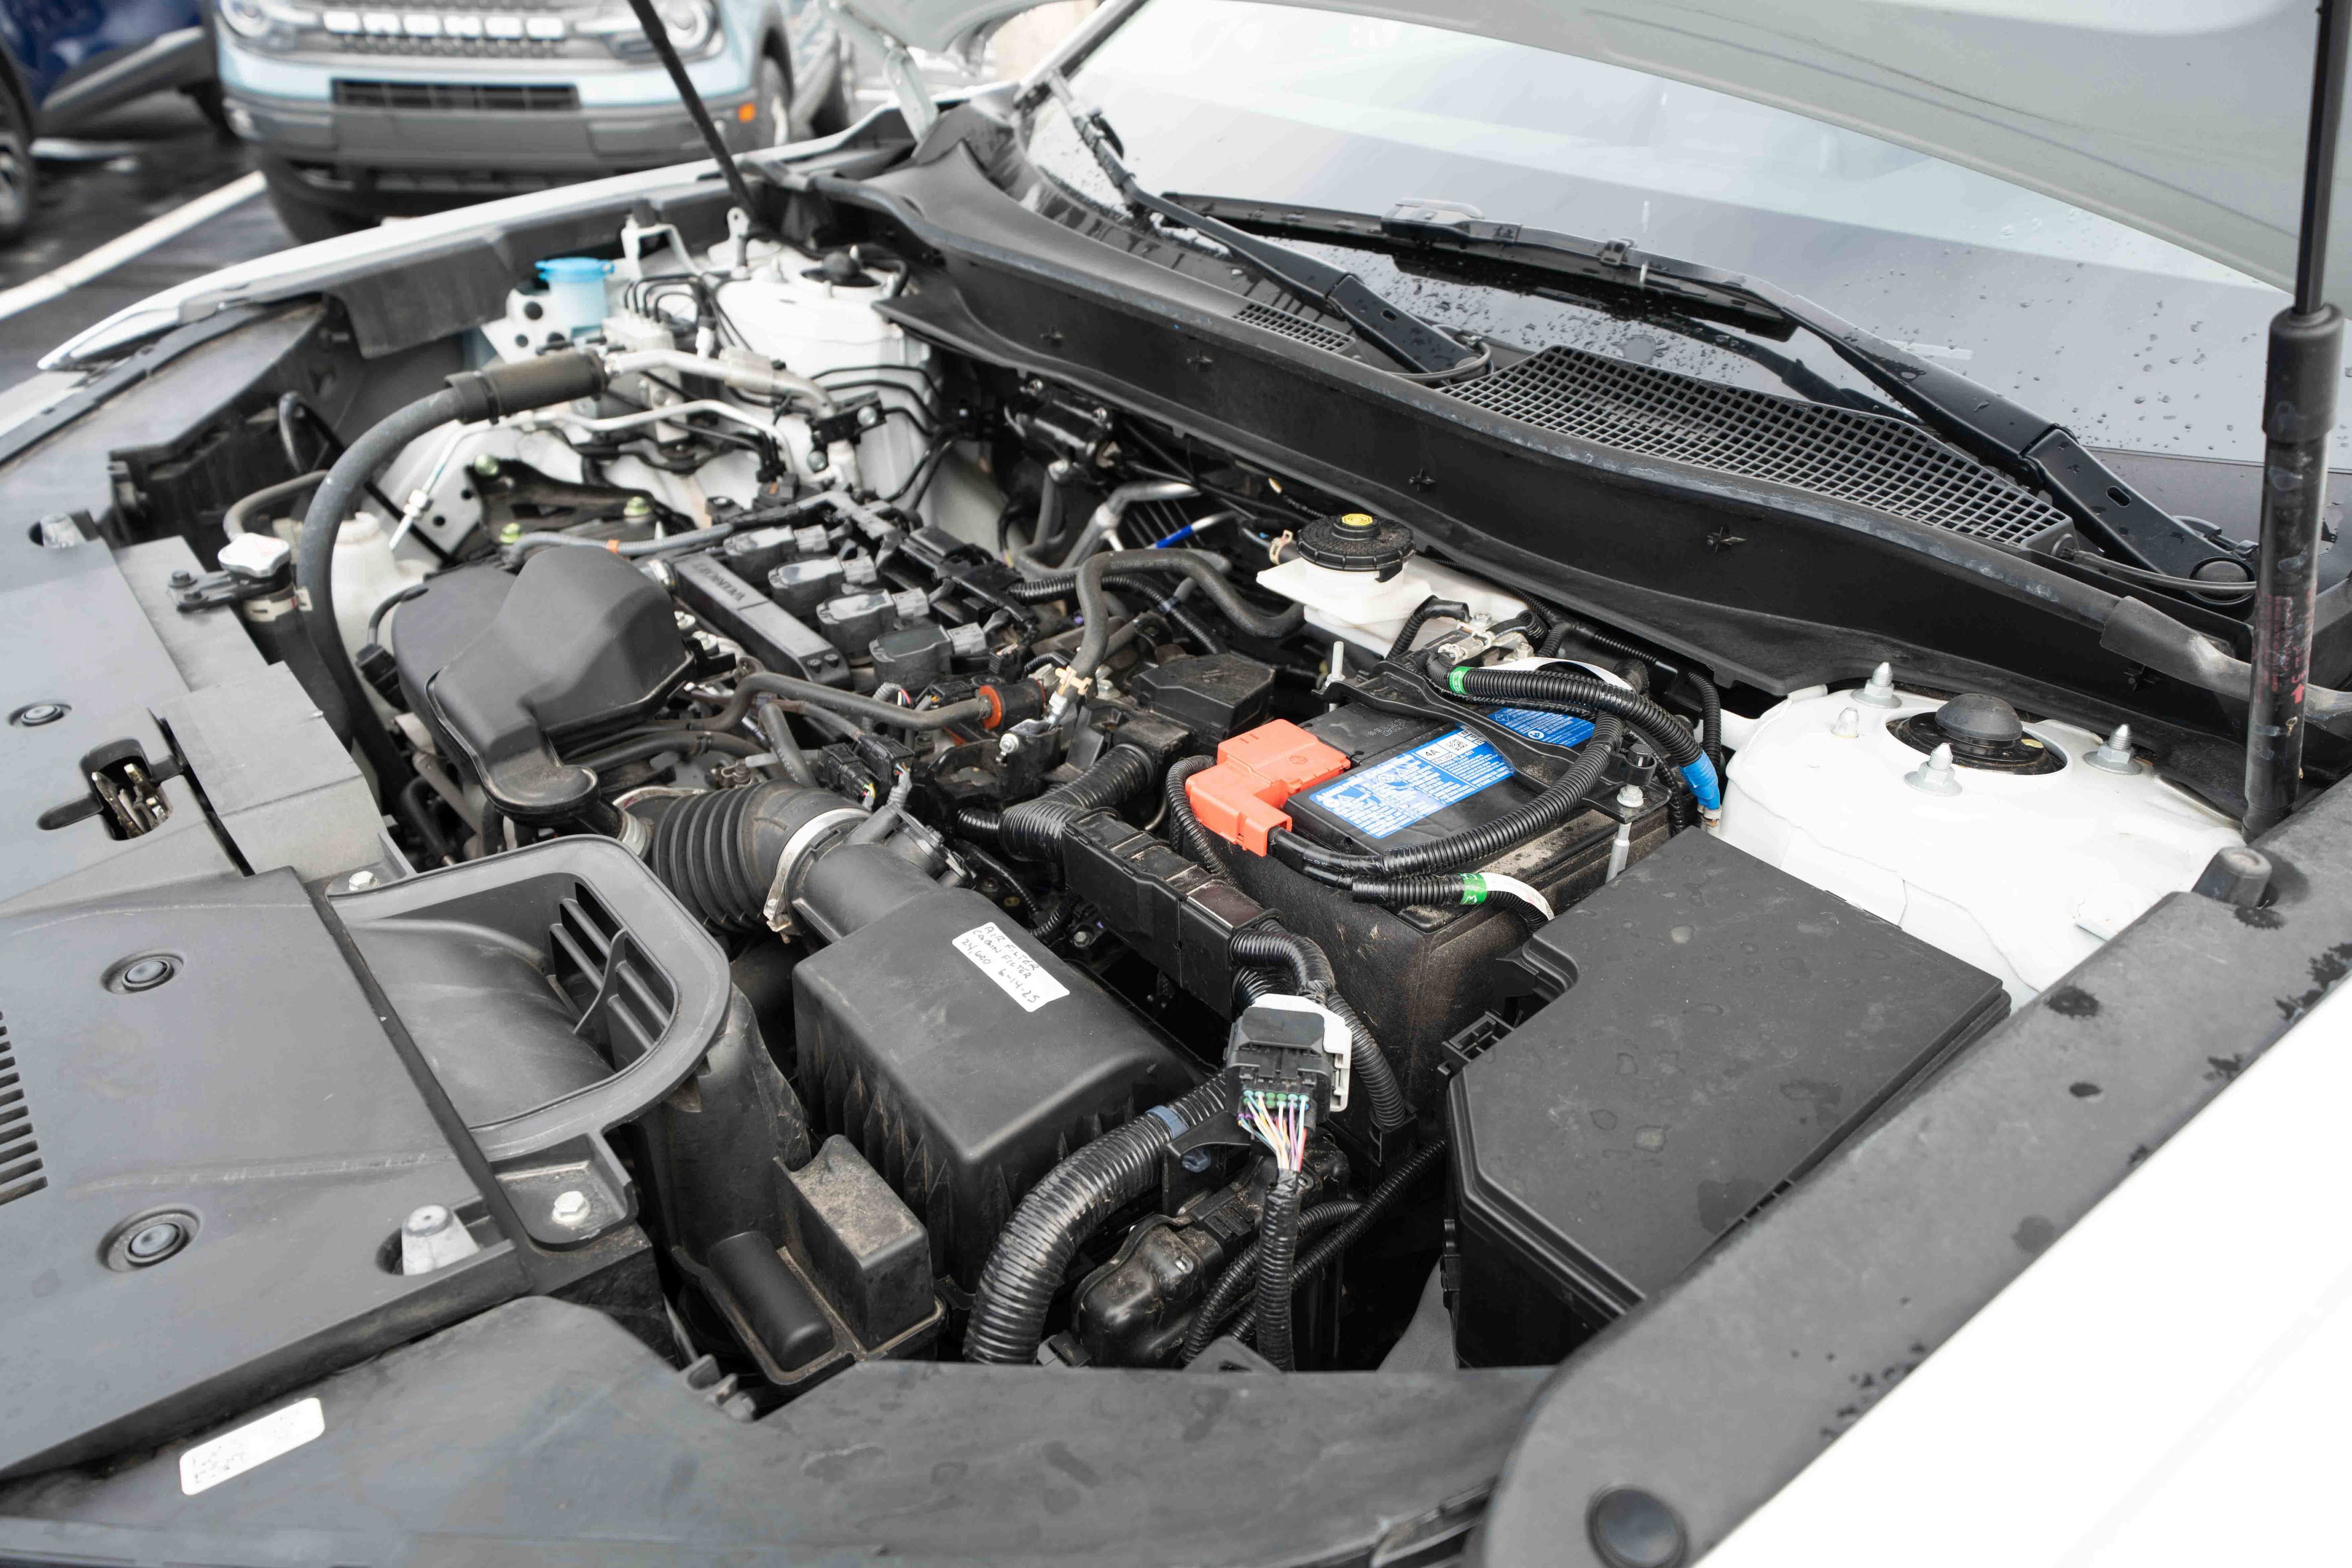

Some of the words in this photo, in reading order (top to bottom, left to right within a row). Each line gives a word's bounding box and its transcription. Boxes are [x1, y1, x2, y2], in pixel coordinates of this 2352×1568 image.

[973, 930, 1002, 953] CABIN
[1001, 955, 1031, 978] FILTER
[985, 927, 1005, 942] AIR
[1005, 944, 1039, 971] FILTER
